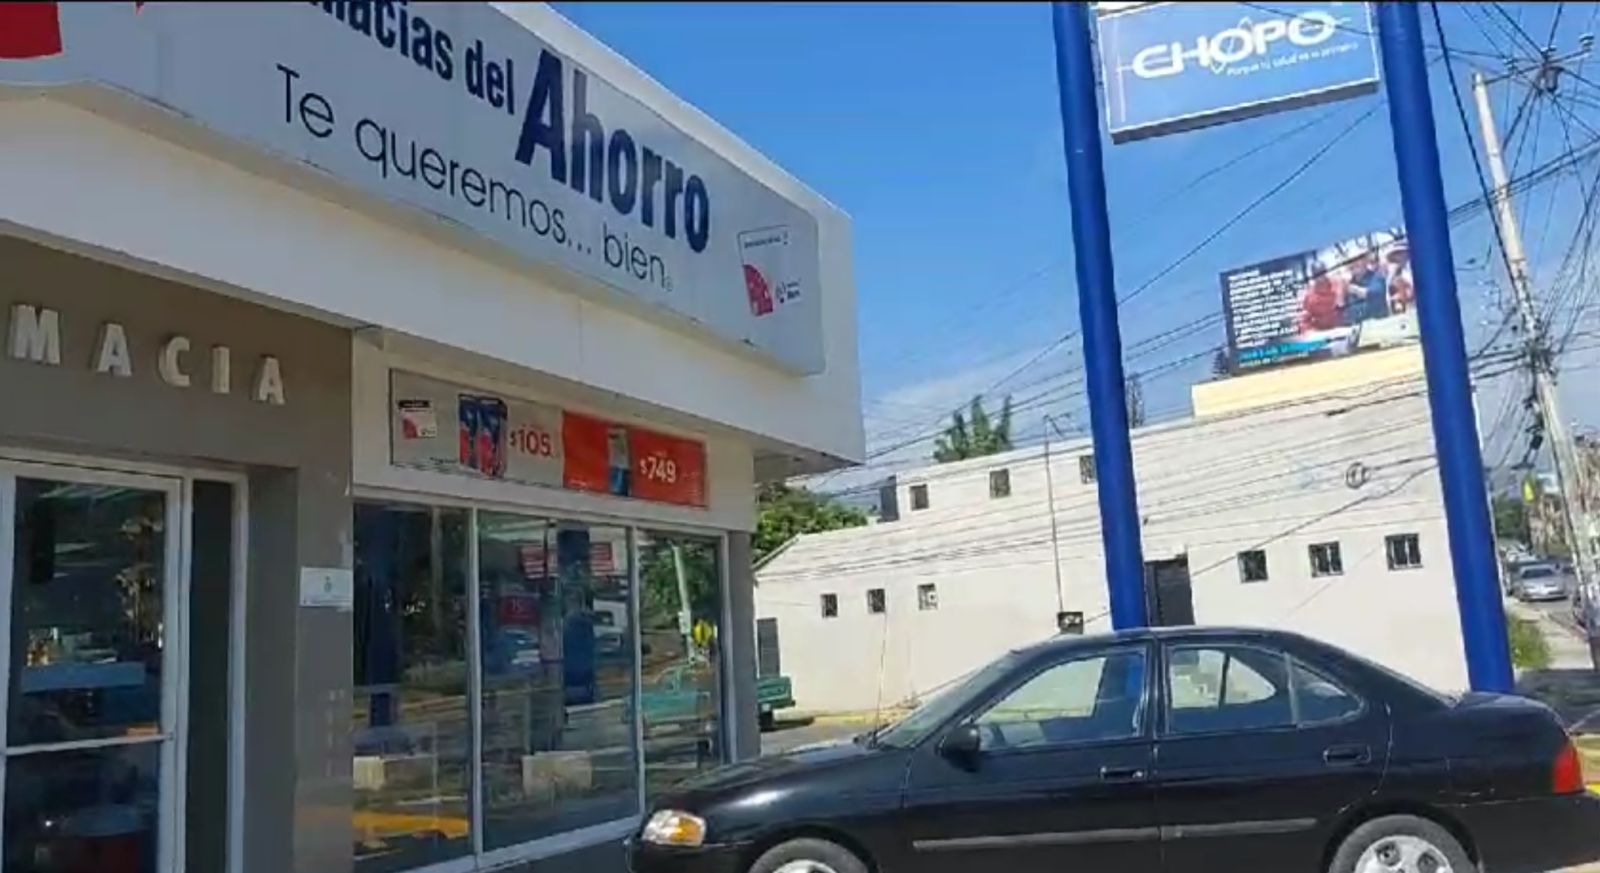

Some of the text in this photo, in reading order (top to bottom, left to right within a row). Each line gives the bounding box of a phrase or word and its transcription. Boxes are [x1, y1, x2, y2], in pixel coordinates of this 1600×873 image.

[276, 64, 335, 138] Te
[354, 116, 592, 256] queremos...
[465, 39, 515, 115] del
[515, 48, 710, 254] Ahorro
[8, 303, 287, 406] MACIA
[639, 455, 677, 484] $749
